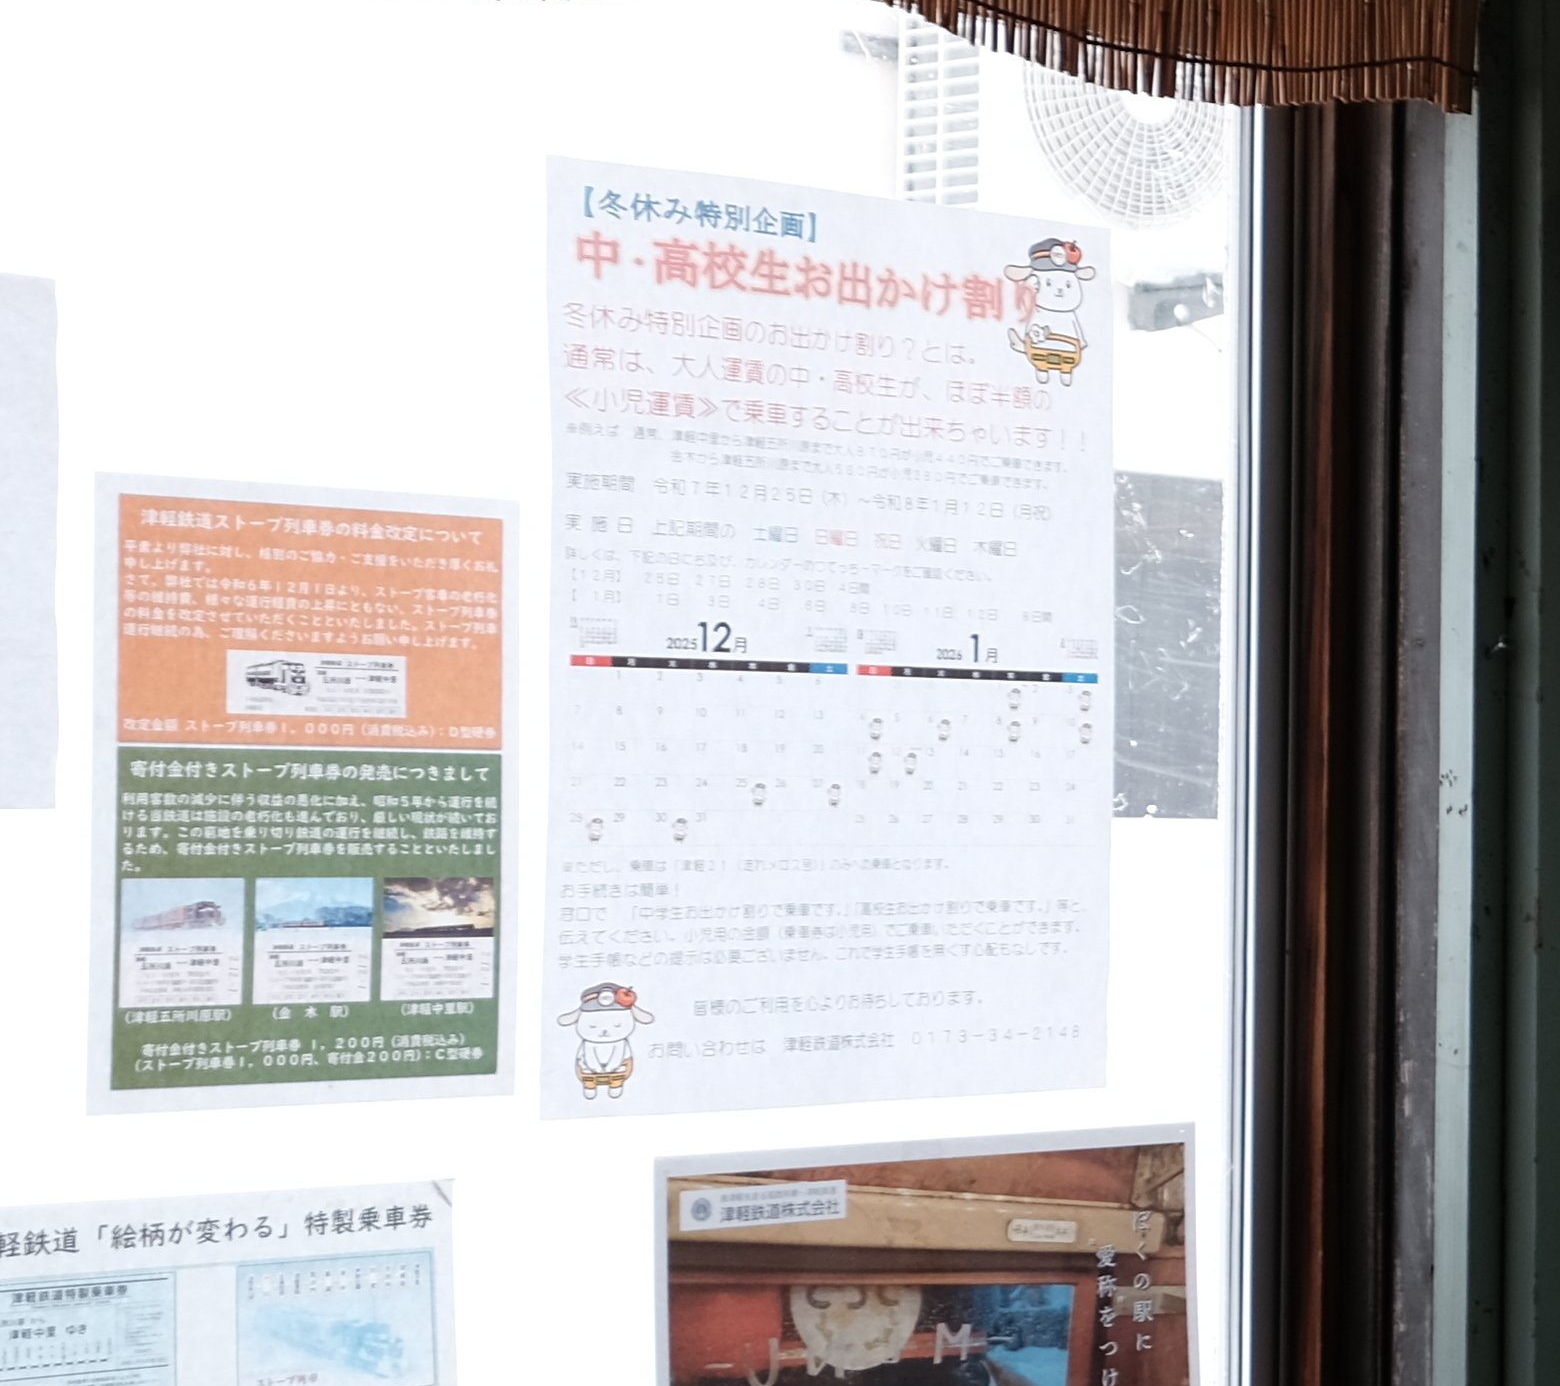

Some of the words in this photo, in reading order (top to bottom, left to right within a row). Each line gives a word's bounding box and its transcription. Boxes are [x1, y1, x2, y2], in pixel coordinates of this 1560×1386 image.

[582, 185, 817, 243] 【冬休み特別企画】
[719, 1199, 842, 1223] 津軽鉄道株式会社
